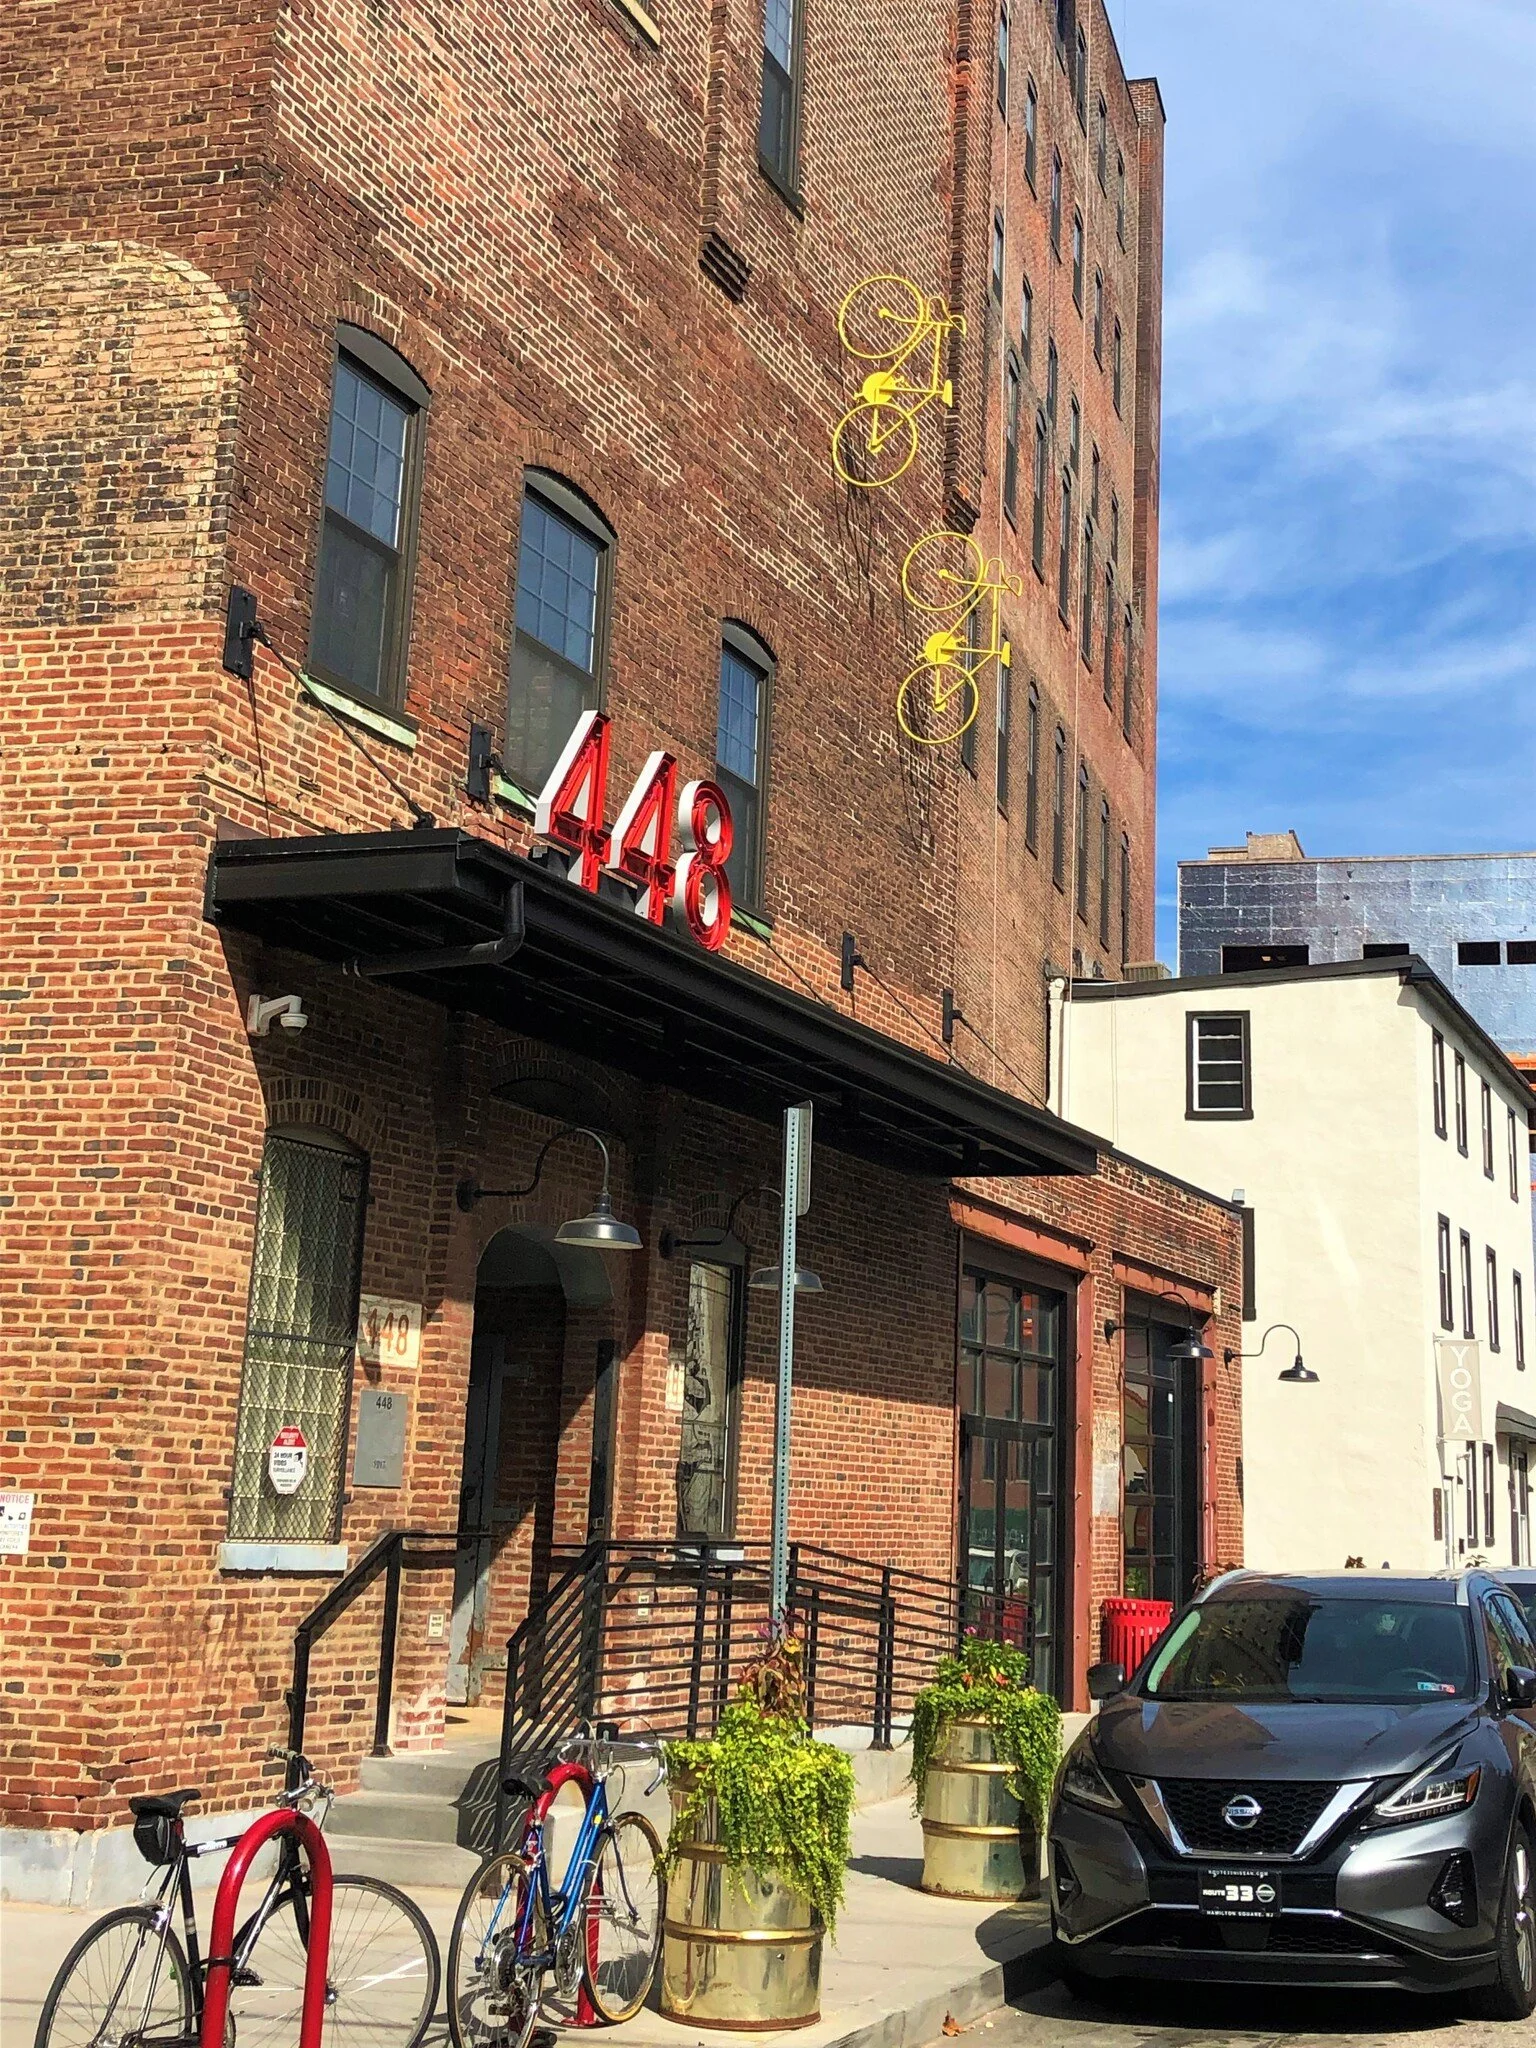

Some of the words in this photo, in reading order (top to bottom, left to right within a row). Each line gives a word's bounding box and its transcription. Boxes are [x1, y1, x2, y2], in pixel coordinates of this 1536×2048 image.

[534, 710, 734, 952] 448
[366, 1308, 409, 1356] 448
[375, 1395, 393, 1410] 448
[1449, 1345, 1474, 1434] YOGA
[0, 1494, 30, 1504] NOTICE
[1202, 1889, 1226, 1897] ROUTE
[1225, 1885, 1254, 1902] 33
